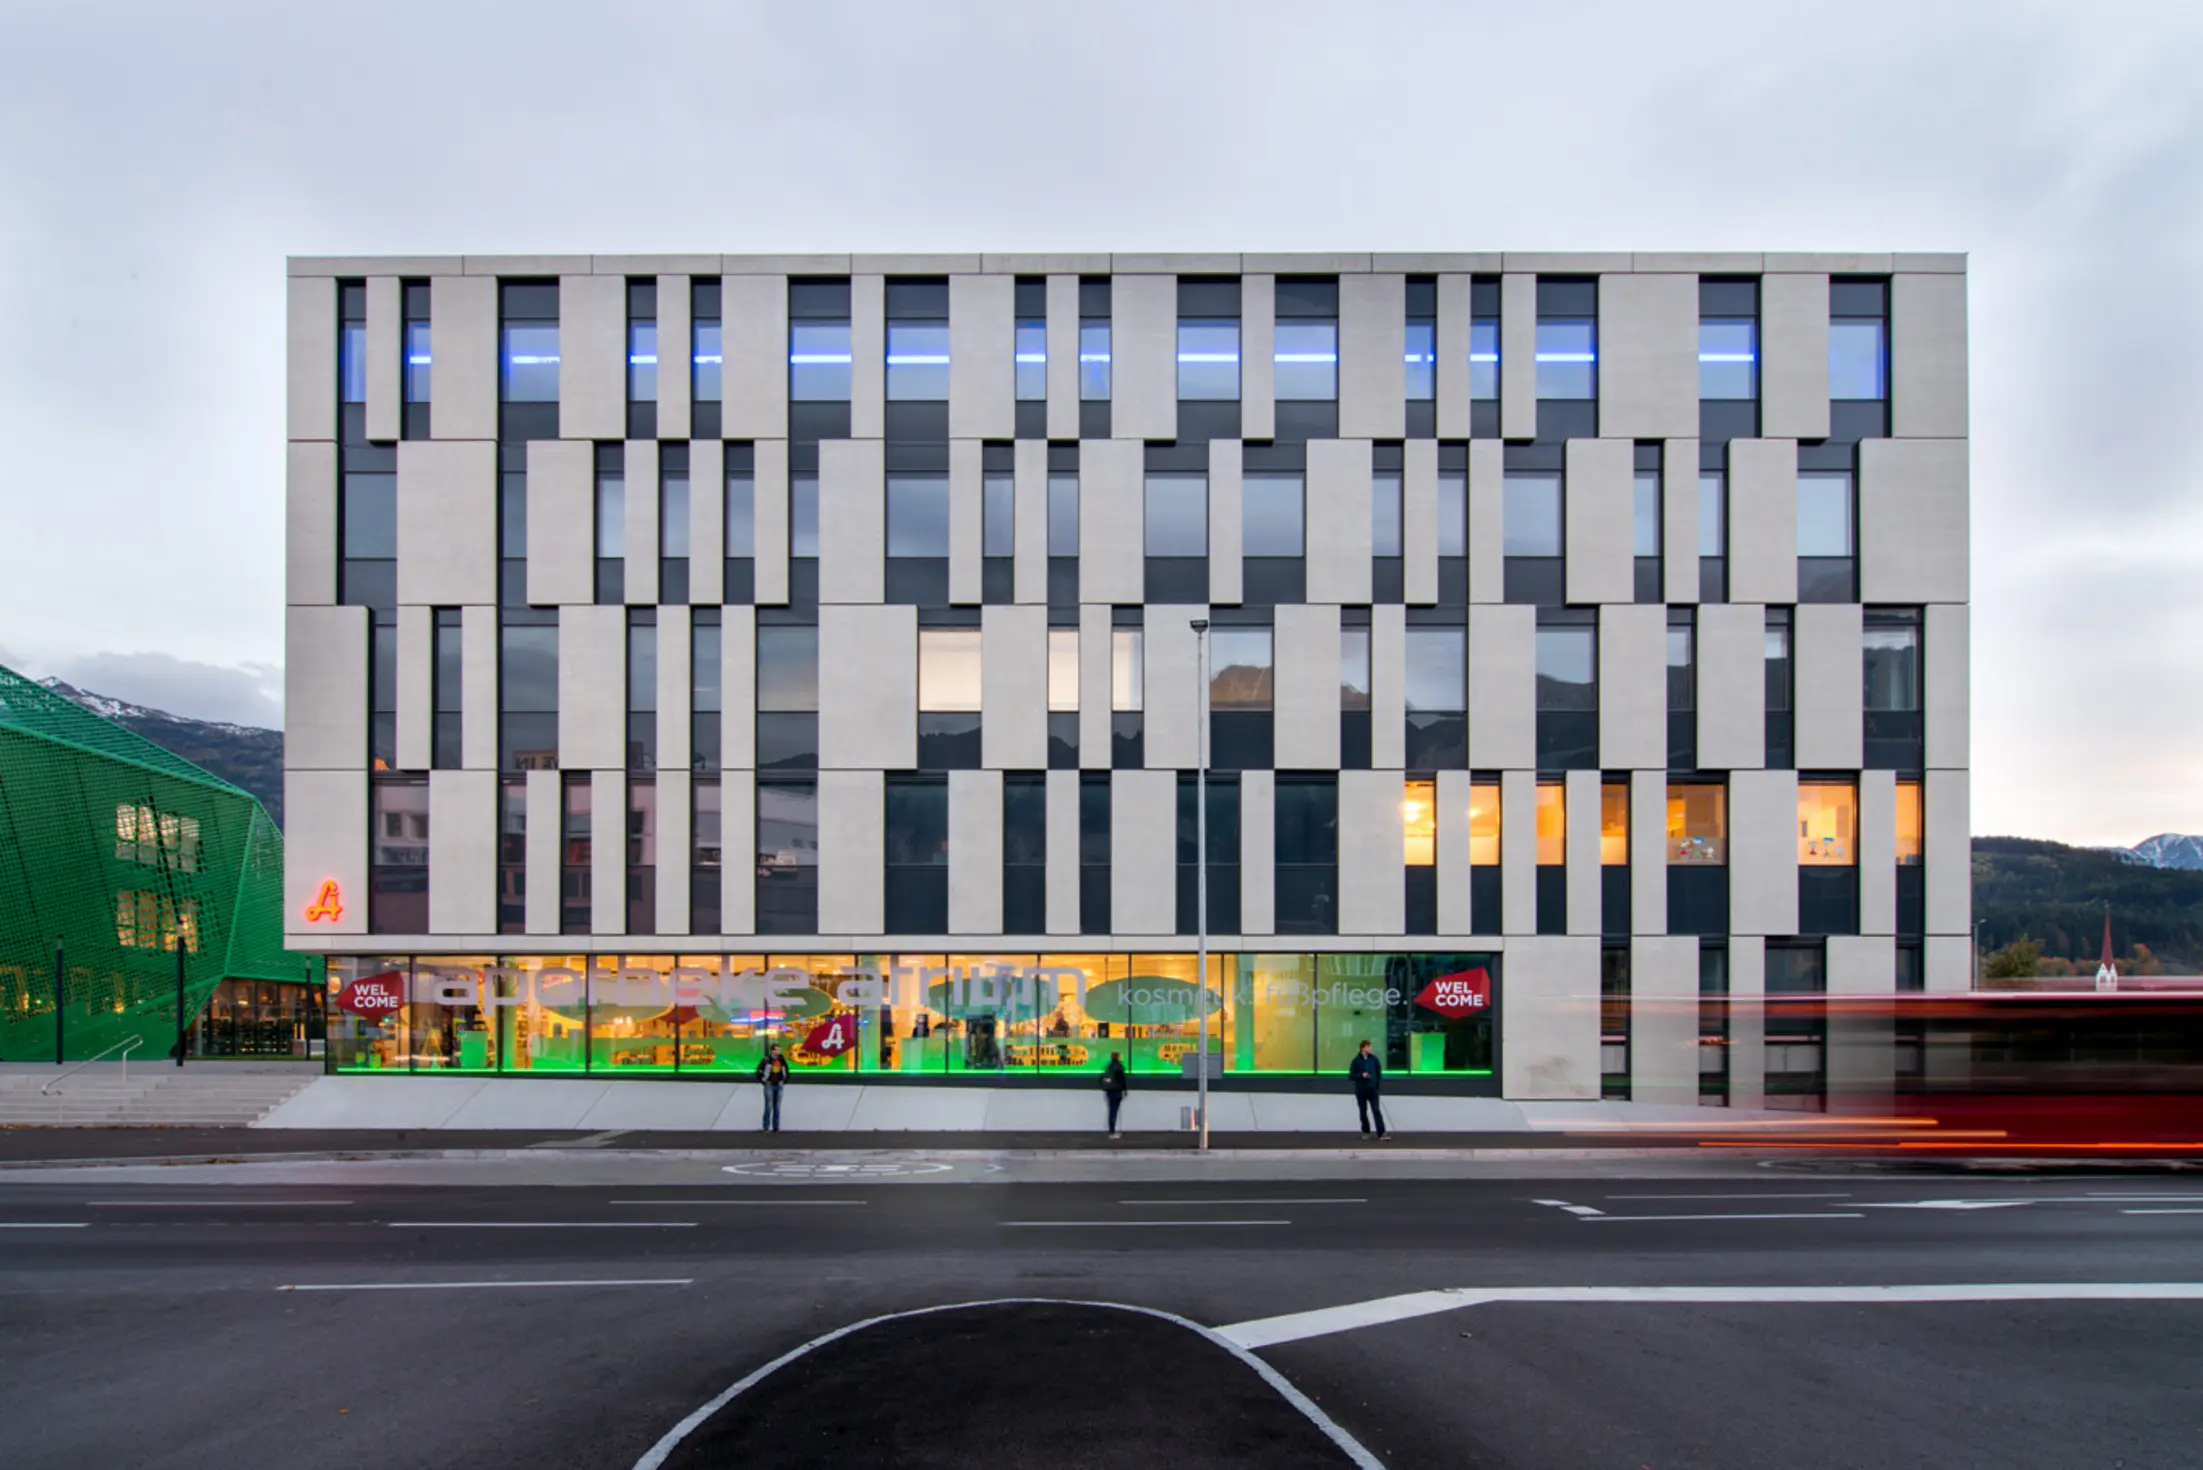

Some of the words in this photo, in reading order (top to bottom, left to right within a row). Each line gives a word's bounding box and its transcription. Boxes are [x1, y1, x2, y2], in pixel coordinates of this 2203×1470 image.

[305, 880, 343, 921] A
[354, 984, 388, 995] WEL
[433, 955, 810, 1016] apotheke
[837, 955, 1086, 1006] atrium
[1436, 981, 1473, 994] WEL
[354, 997, 398, 1008] COME
[1435, 994, 1483, 1007] COME
[821, 1023, 845, 1049] A
